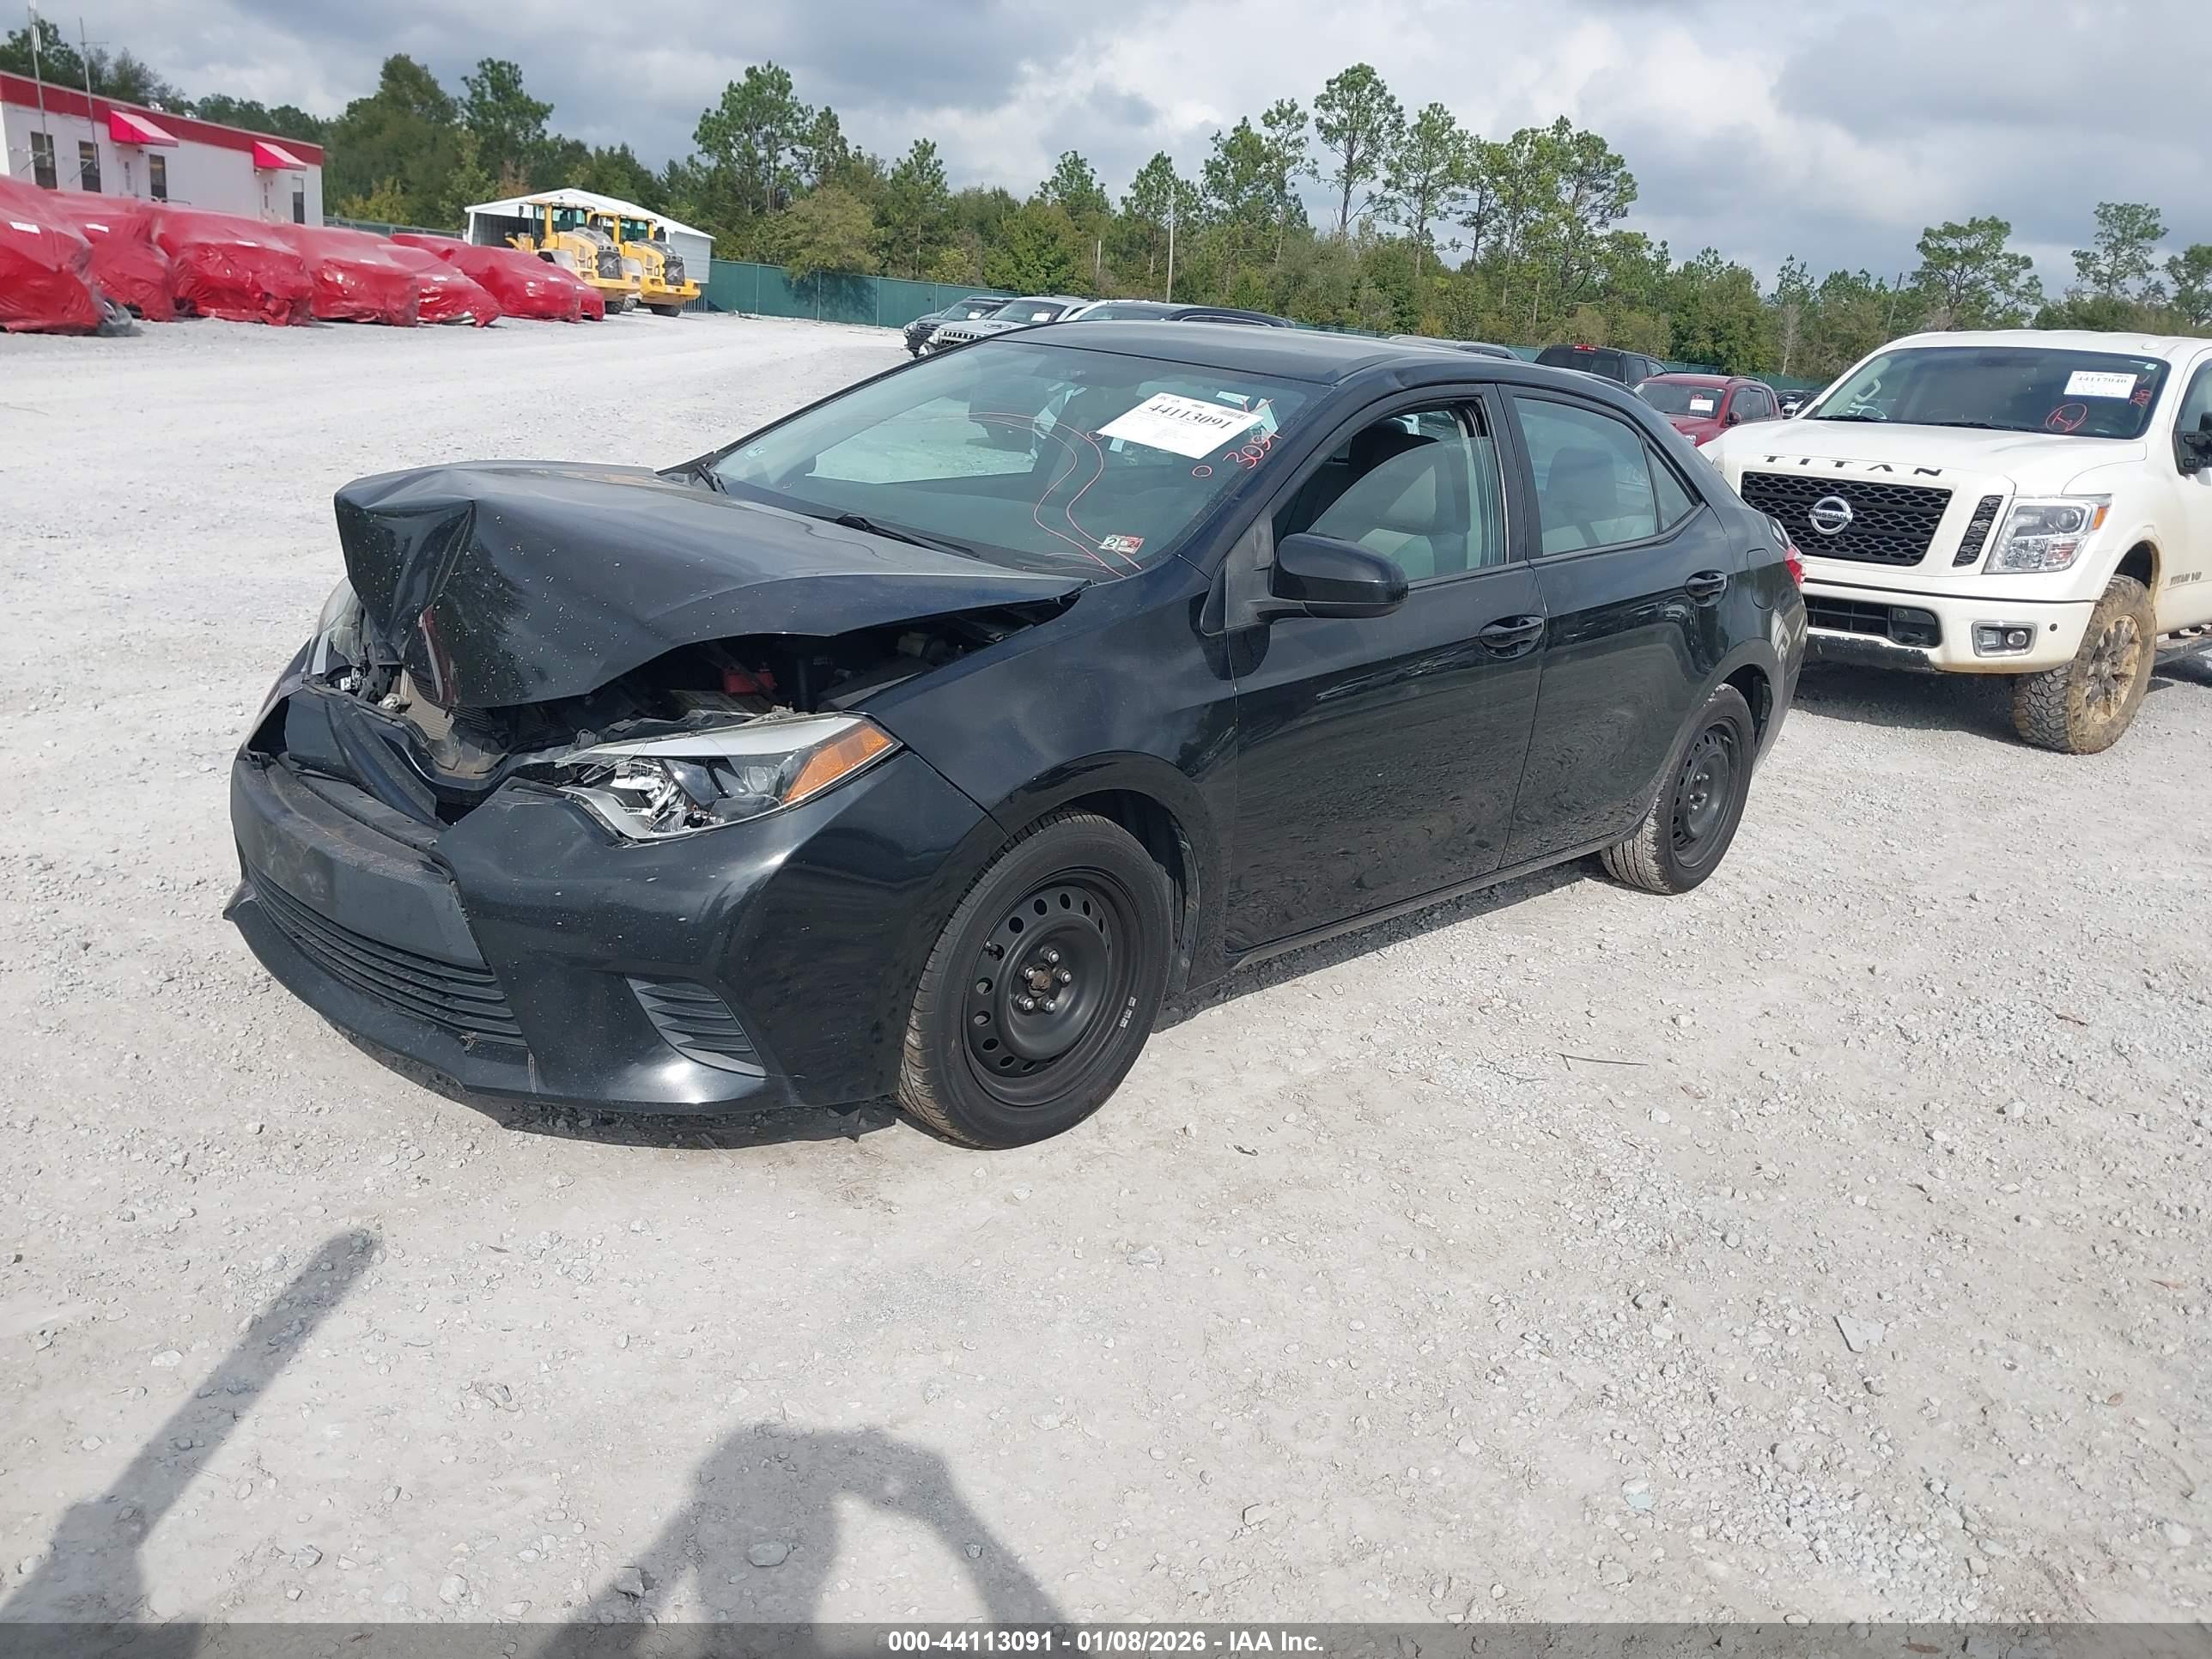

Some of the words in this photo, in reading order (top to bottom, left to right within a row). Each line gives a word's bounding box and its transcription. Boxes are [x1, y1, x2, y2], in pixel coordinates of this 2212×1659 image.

[1149, 404, 1233, 428] 44113091
[1763, 454, 1943, 477] TITAN
[1811, 508, 1847, 520] NISSAN
